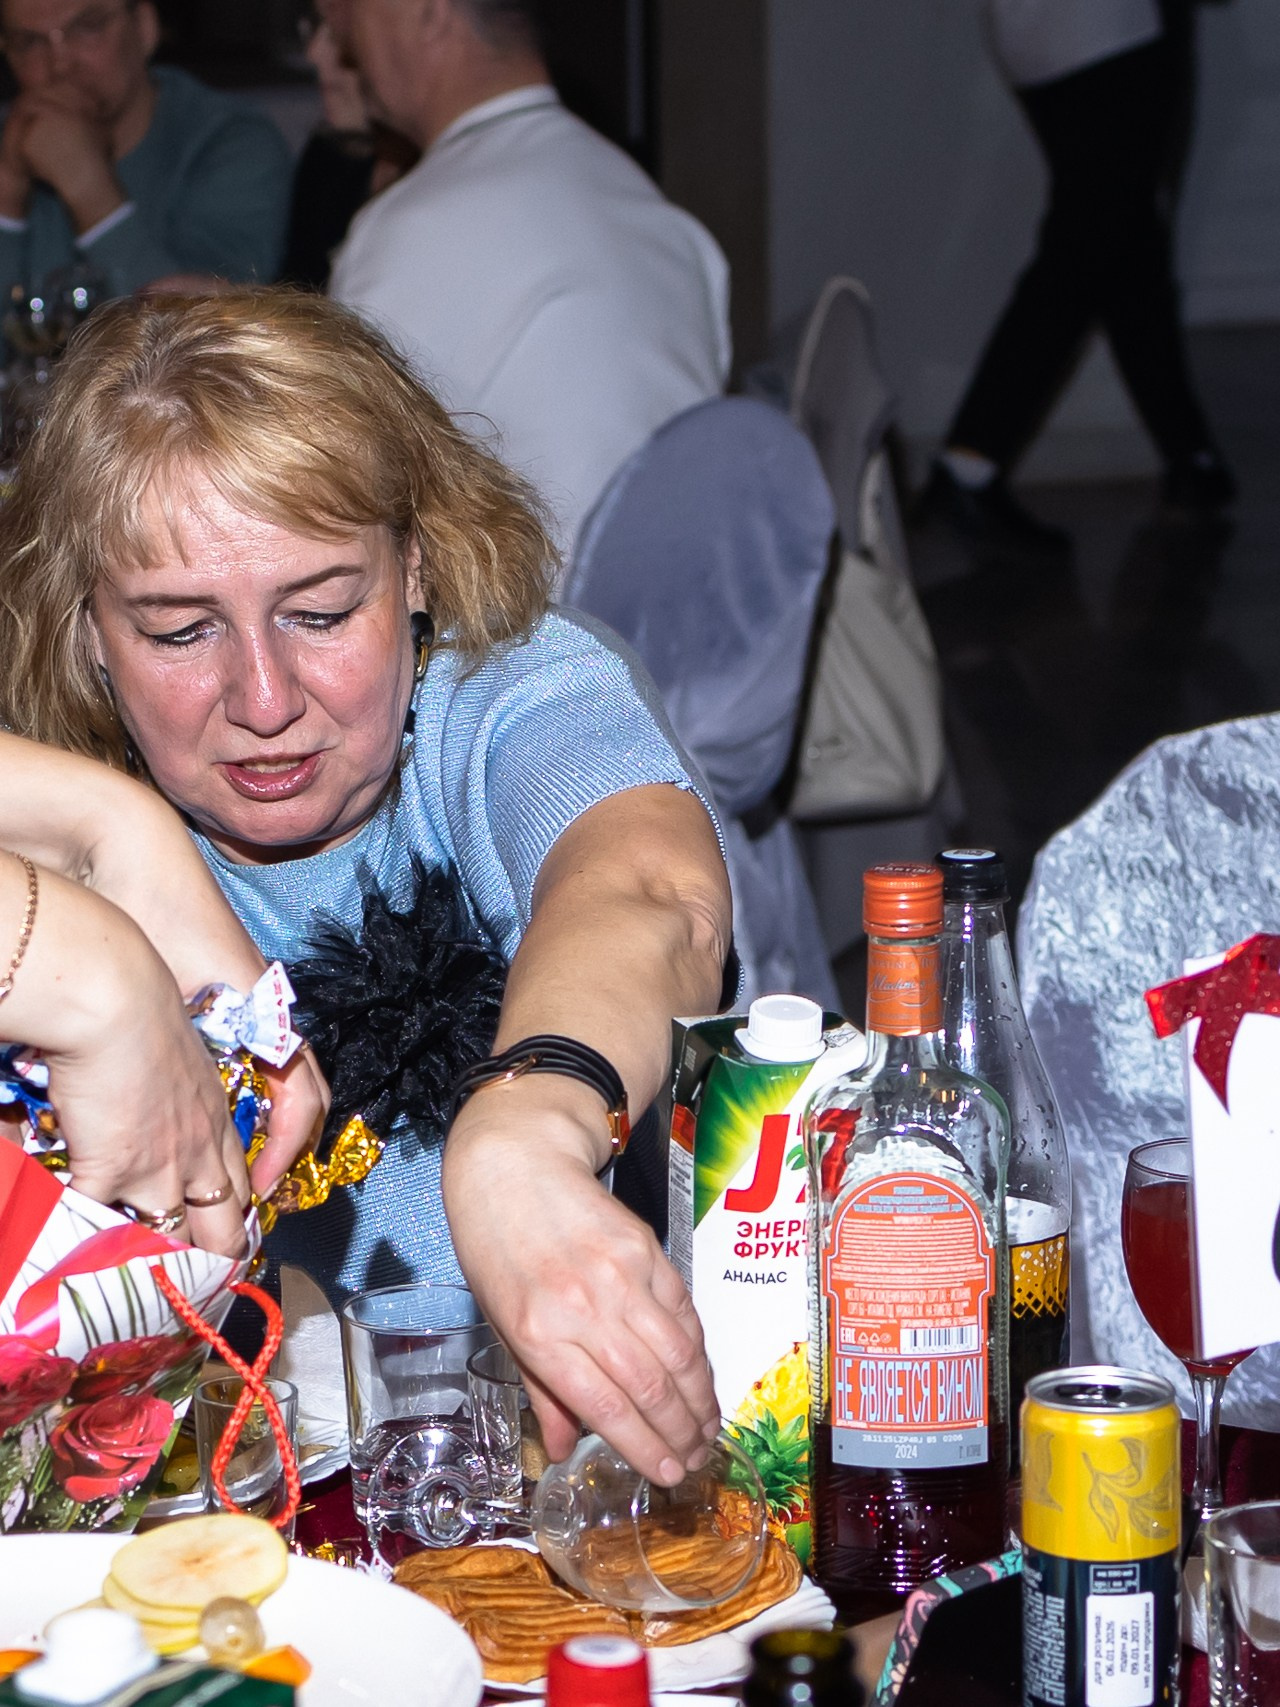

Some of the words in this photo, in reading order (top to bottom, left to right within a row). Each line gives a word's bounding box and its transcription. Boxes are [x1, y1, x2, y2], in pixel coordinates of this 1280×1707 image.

[723, 1269, 788, 1285] АНАНАС
[835, 1357, 853, 1420] НЕ
[859, 1360, 931, 1423] ЯВЛЯЕТСЯ
[937, 1357, 984, 1422] ВИНОМ
[895, 1444, 918, 1459] 2024
